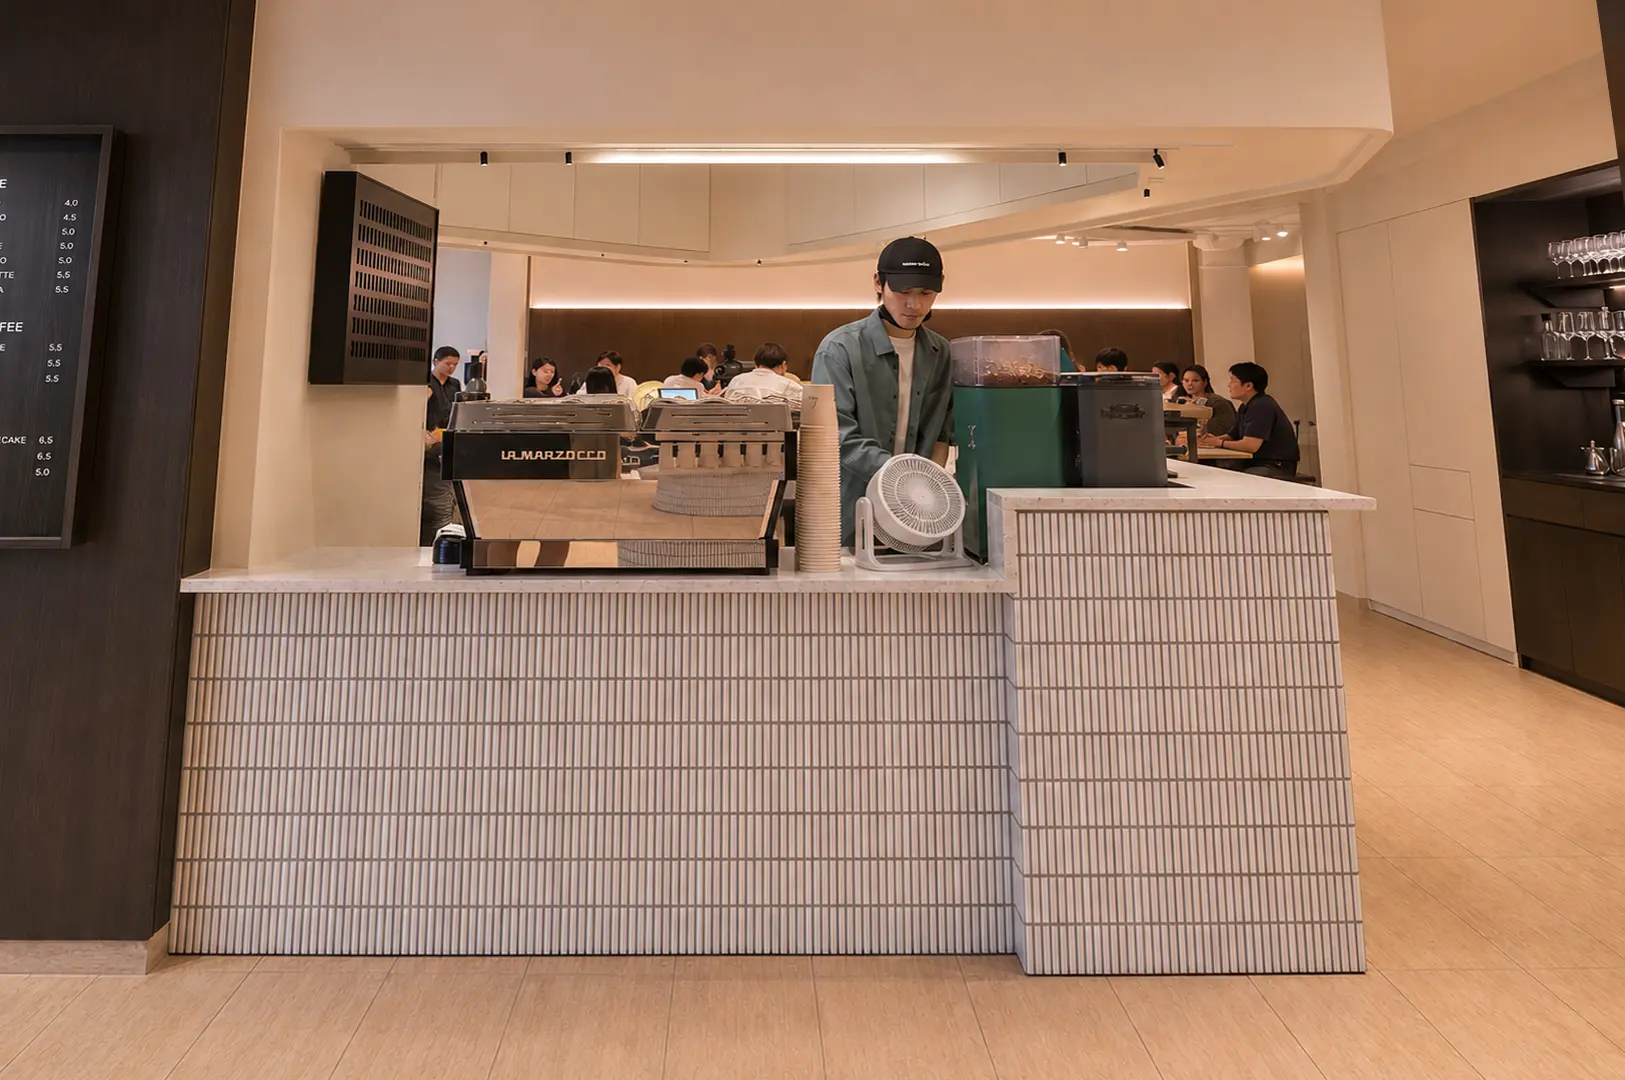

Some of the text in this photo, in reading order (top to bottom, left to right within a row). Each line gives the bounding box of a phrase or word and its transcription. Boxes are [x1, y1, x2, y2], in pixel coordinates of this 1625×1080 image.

[64, 199, 79, 207] 4.0
[63, 213, 77, 221] 4.5
[61, 227, 76, 236] 5.0
[60, 242, 74, 250] 5.0
[58, 256, 73, 264] 5.0
[56, 271, 71, 279] 5.5
[55, 285, 69, 294] 5.5
[48, 343, 63, 352] 5.5
[47, 359, 61, 367] 5.5
[45, 374, 59, 383] 5.5
[0, 435, 54, 445] CAKE 6.5
[36, 451, 52, 461] 6.5
[501, 450, 606, 460] LA MARZOCCO
[35, 467, 50, 477] 5.0
